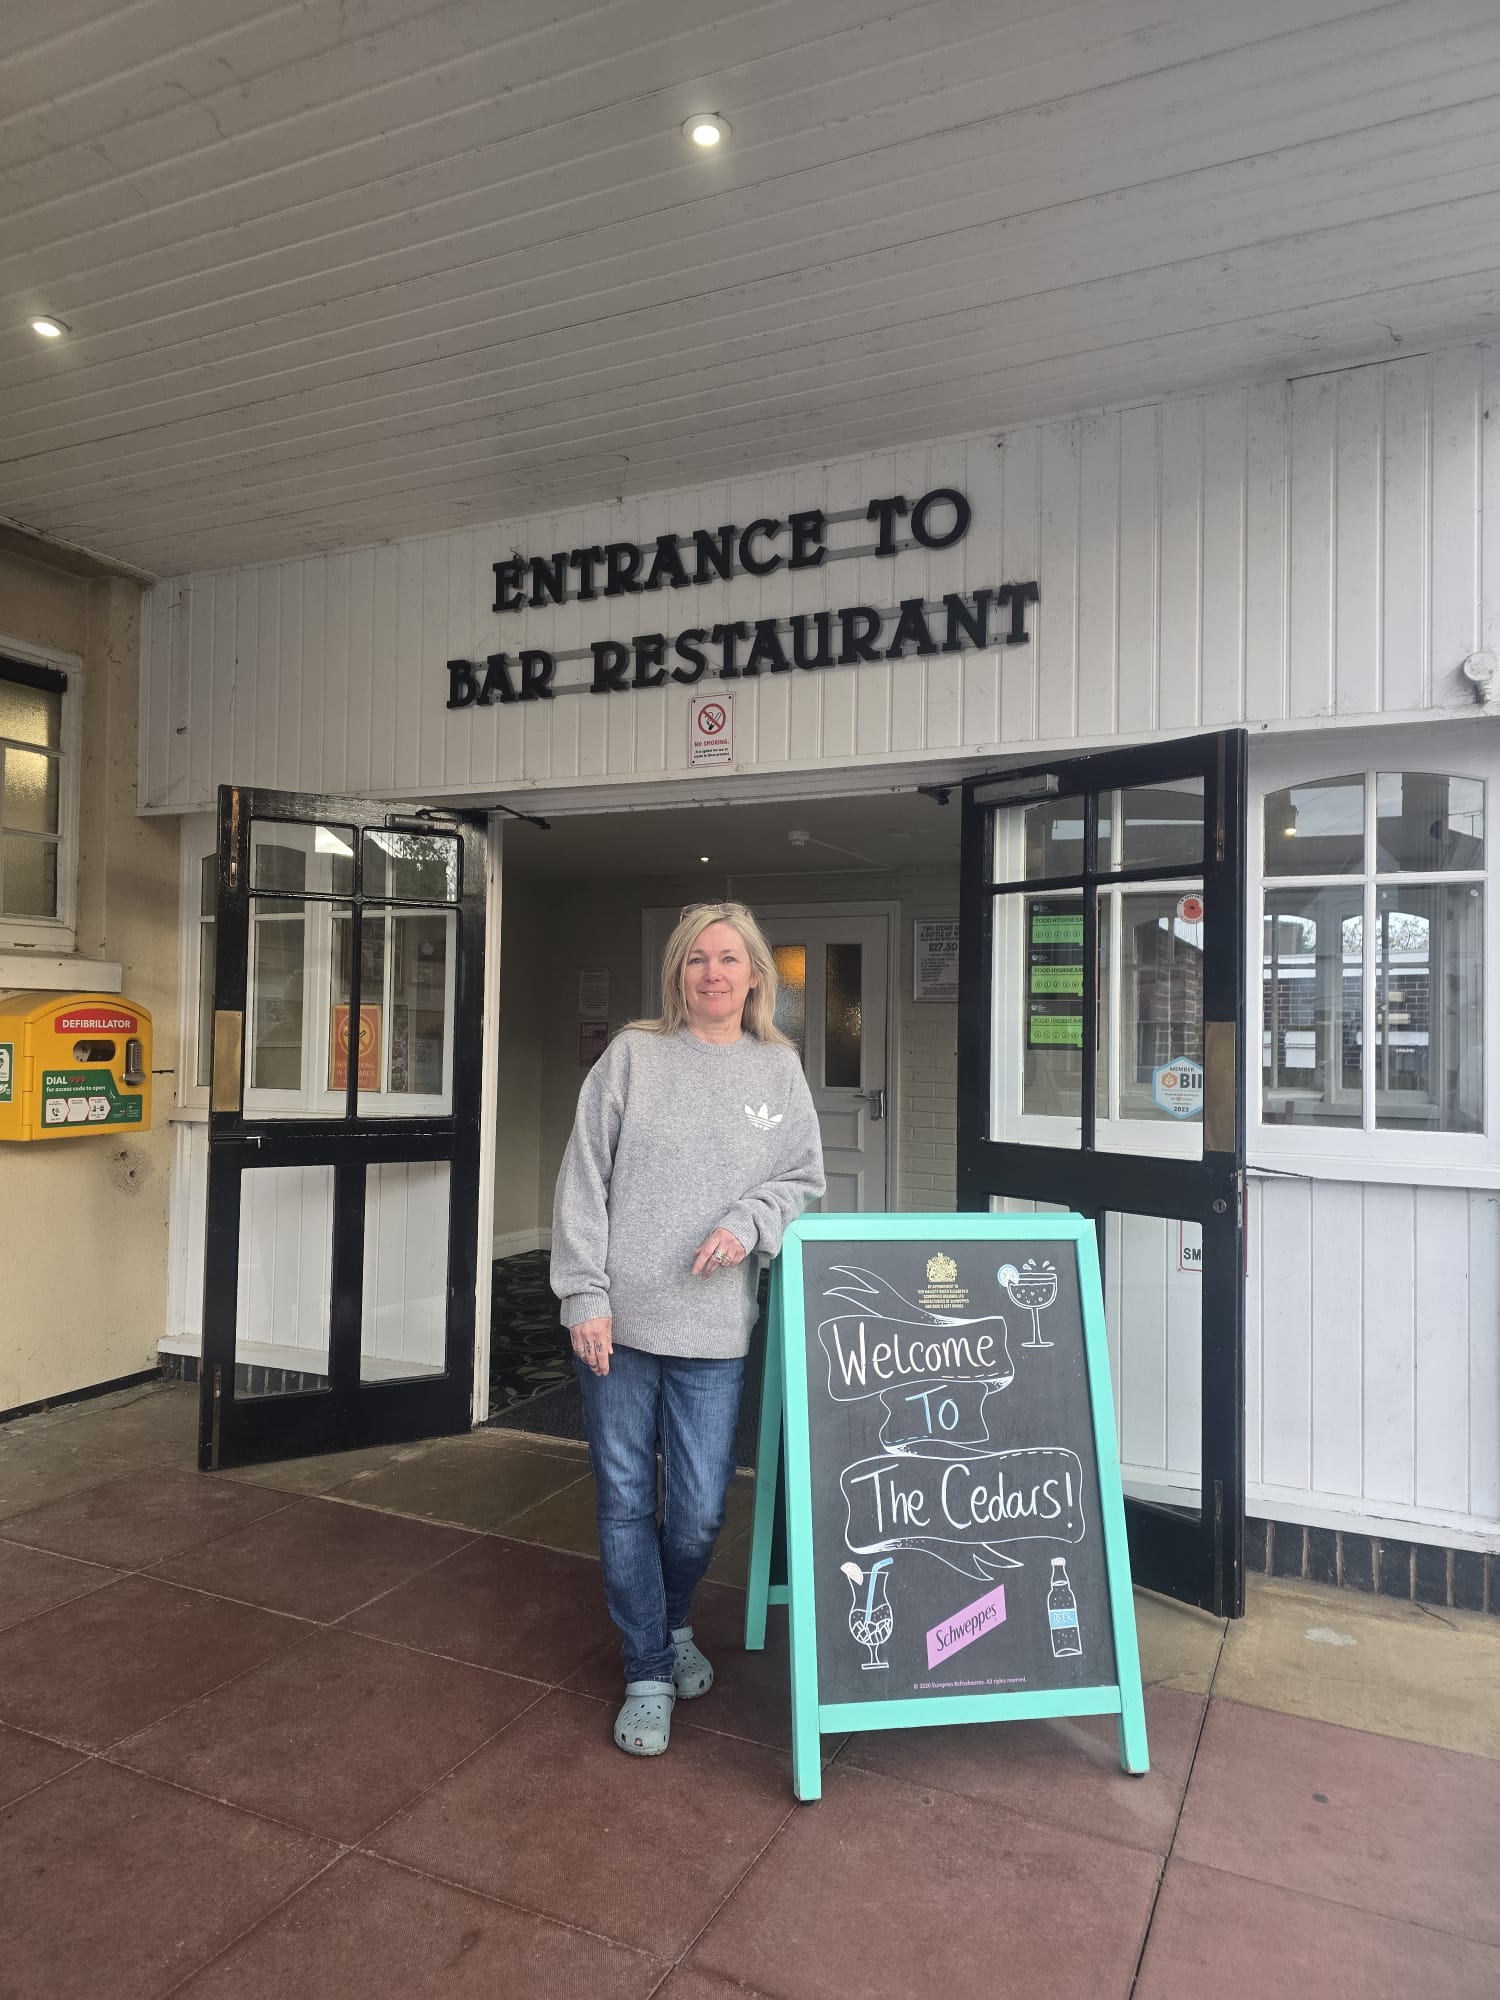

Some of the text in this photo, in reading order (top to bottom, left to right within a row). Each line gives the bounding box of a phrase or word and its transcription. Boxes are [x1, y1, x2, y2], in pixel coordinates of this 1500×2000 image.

[492, 488, 971, 612] ENTRANCE TO
[446, 581, 1040, 709] BAR RESTAURANT
[62, 1019, 131, 1028] DEFIBRILLATOR
[46, 1076, 68, 1085] DIAL
[1180, 1074, 1202, 1088] BII
[833, 1321, 996, 1385] Welcome
[905, 1384, 959, 1433] To
[851, 1463, 1074, 1533] The Cedars!
[935, 1603, 997, 1652] Schweppes
[1054, 1613, 1073, 1624] BEER
